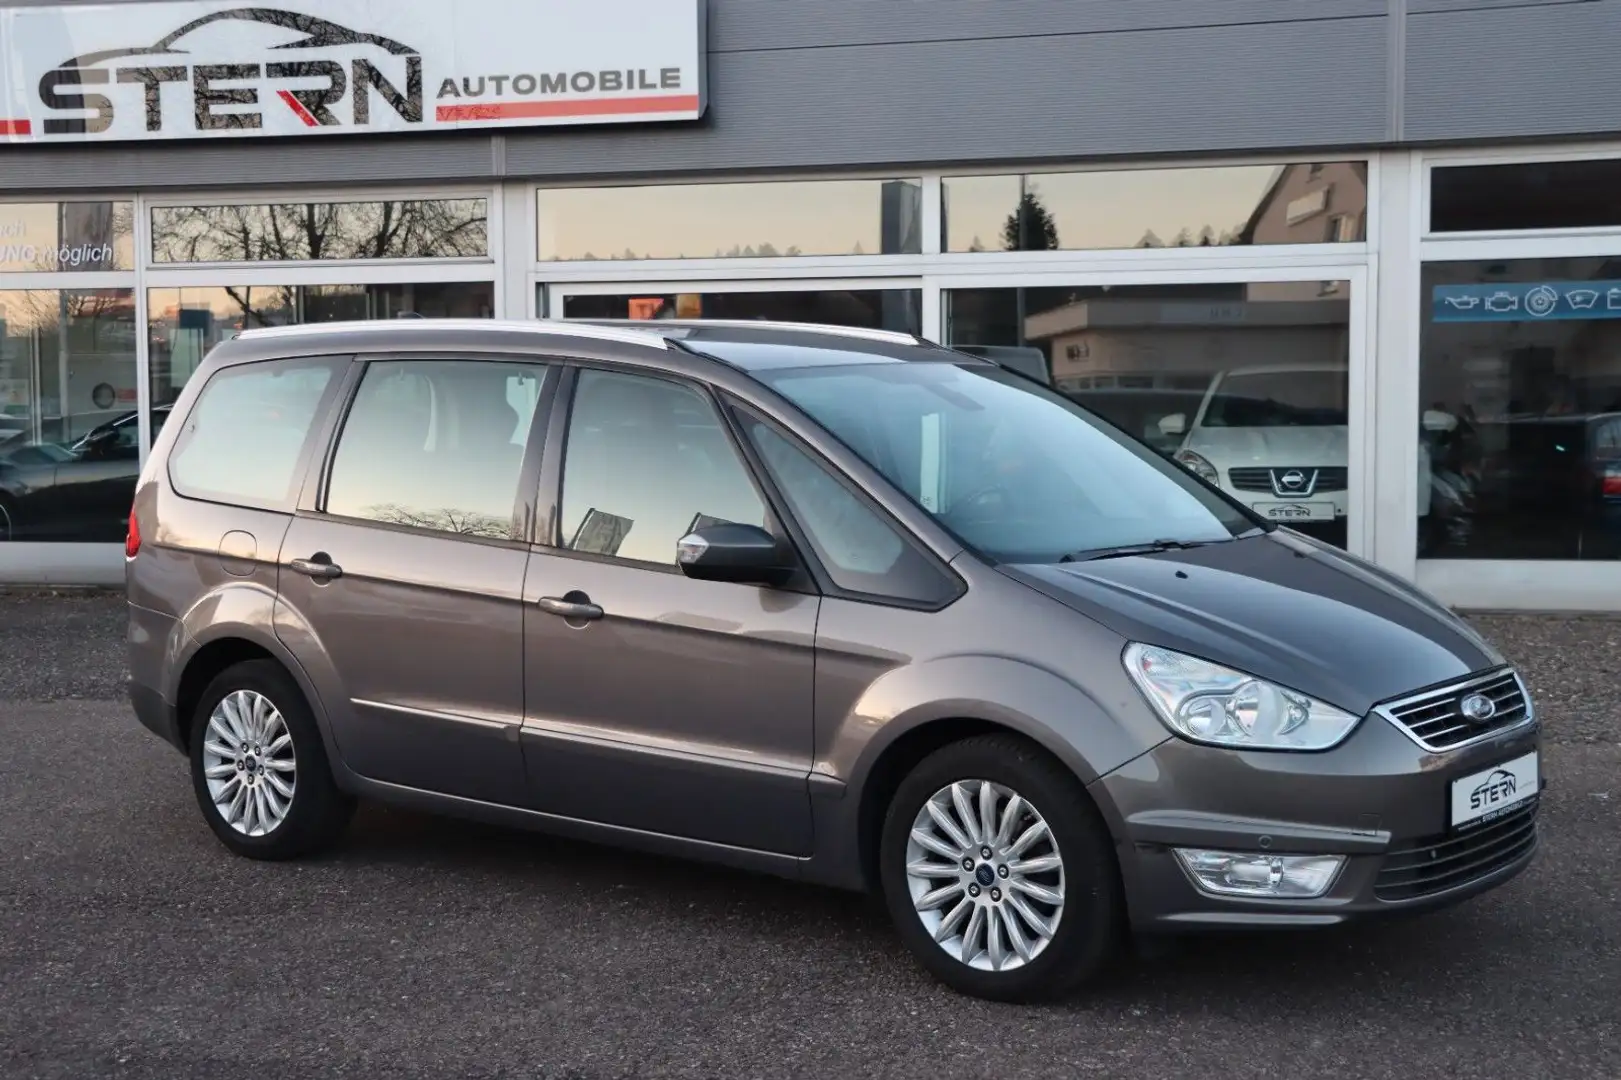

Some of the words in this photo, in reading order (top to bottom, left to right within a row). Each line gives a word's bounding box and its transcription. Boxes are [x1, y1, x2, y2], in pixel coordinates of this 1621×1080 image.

[39, 57, 423, 134] STERN
[436, 67, 681, 99] AUTOMOBILE
[40, 243, 113, 267] möglich
[1268, 509, 1311, 517] STERN
[1470, 777, 1516, 810] STERN
